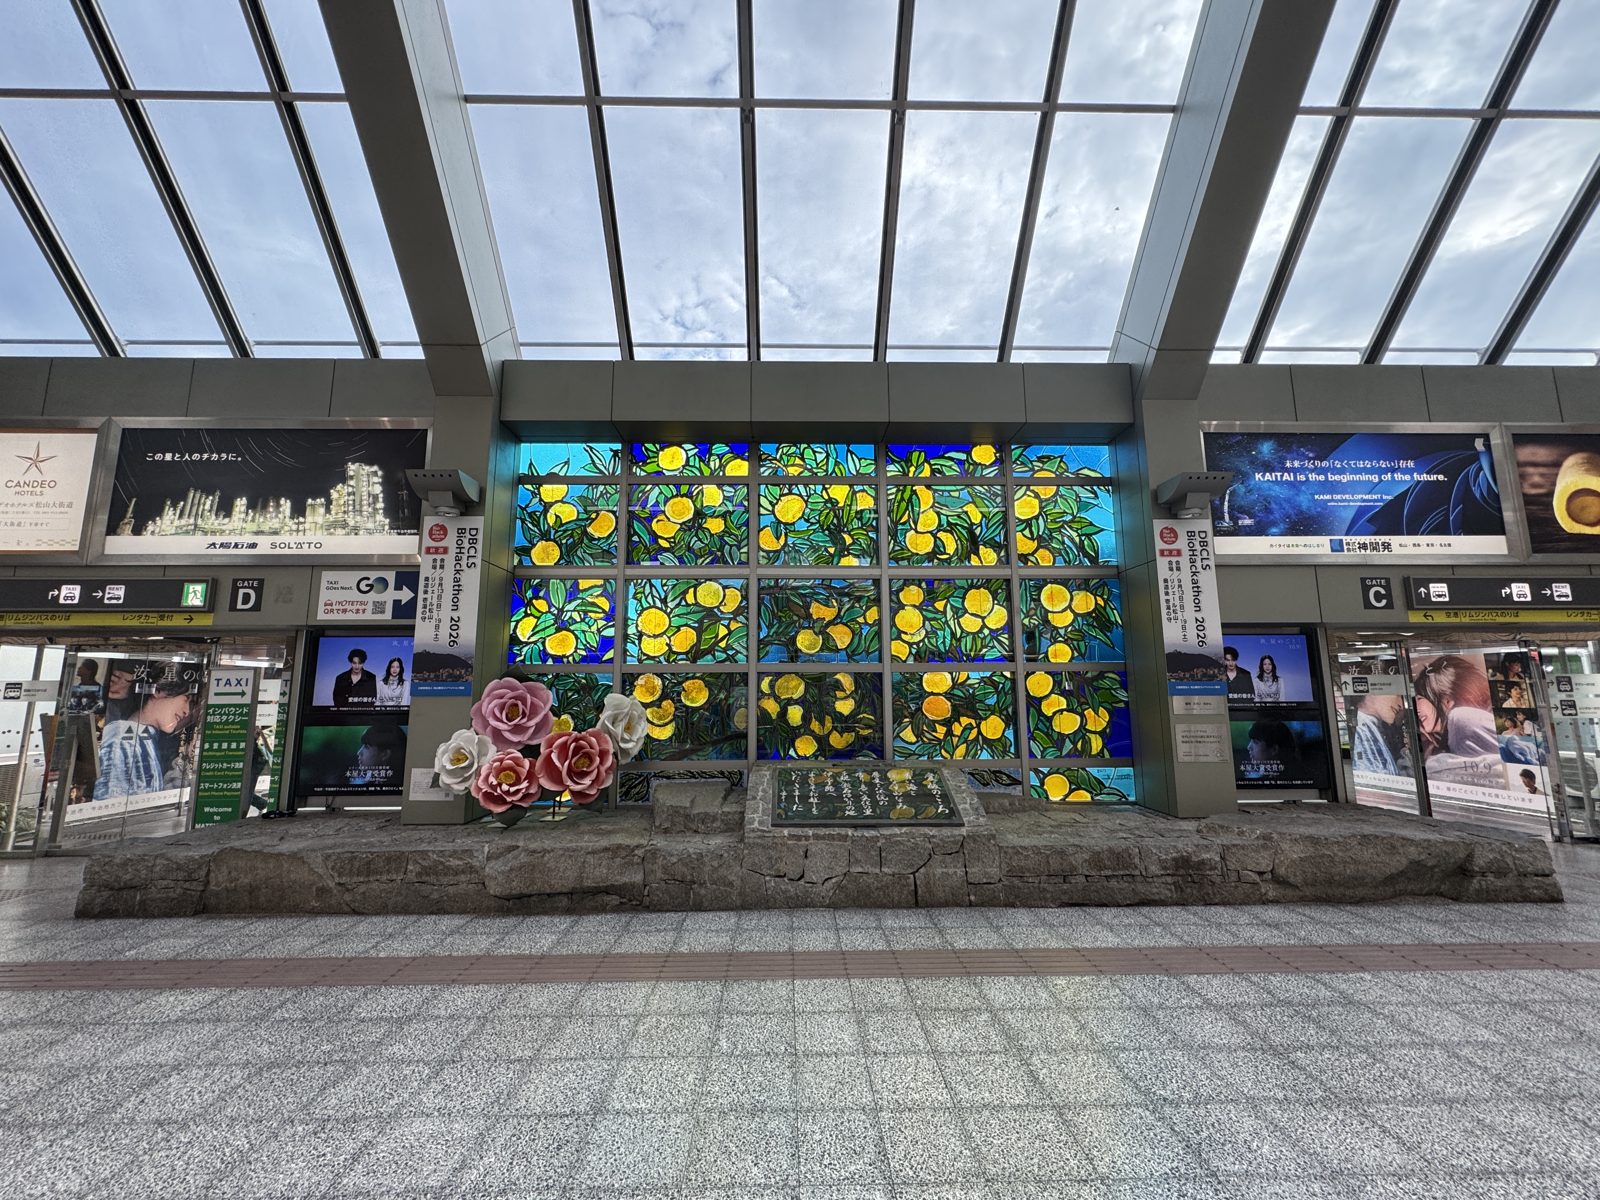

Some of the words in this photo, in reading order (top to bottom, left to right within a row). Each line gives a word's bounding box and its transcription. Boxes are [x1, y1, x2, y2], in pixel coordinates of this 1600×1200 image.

[145, 452, 243, 462] この星と人のチカラに。
[1284, 459, 1415, 469] 未来づくりの「なくてはならない」存在
[4, 479, 57, 489] CANDEO
[1255, 472, 1294, 481] KAITAI
[1296, 472, 1306, 481] is
[1308, 472, 1325, 481] the
[1328, 472, 1379, 483] beginning
[1381, 472, 1392, 481] of
[1394, 472, 1411, 481] the
[1413, 472, 1448, 481] future.
[205, 541, 258, 550] 太陽石油
[466, 527, 479, 569] DBCLS
[1198, 530, 1211, 571] DBCLS
[1357, 541, 1393, 553] 神開発
[451, 527, 466, 612] BioHackathon
[356, 576, 389, 594] GO
[1186, 530, 1202, 613] BioHackathon
[1194, 616, 1207, 648] 2026
[236, 589, 256, 609] D
[1368, 586, 1387, 607] C
[122, 613, 174, 622] レンタカー受付
[448, 616, 460, 648] 2026
[215, 678, 249, 687] TAXI
[207, 707, 249, 715] インバウンド
[1462, 760, 1492, 774] 10.9
